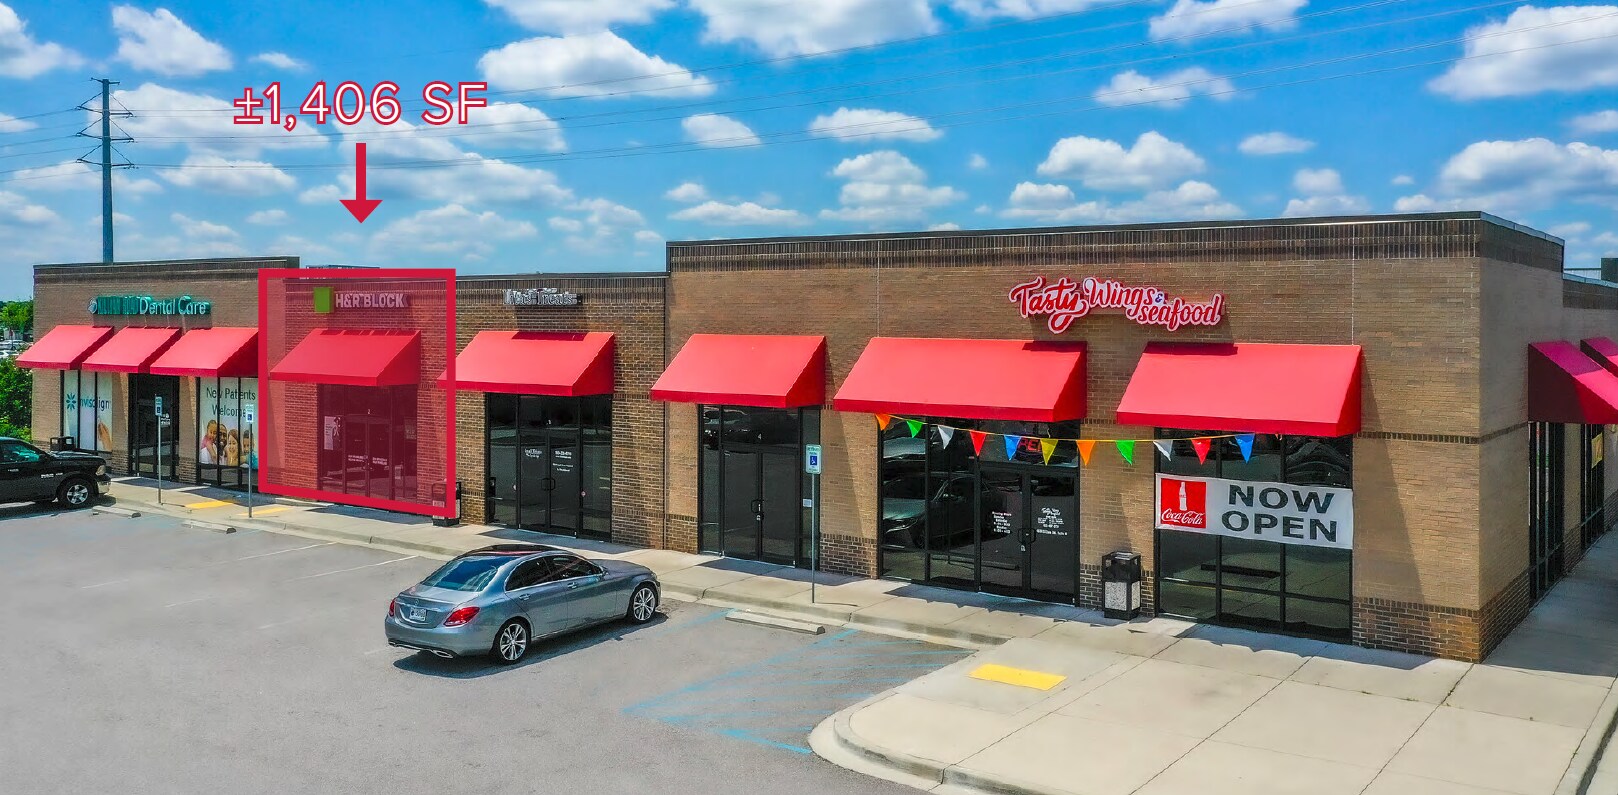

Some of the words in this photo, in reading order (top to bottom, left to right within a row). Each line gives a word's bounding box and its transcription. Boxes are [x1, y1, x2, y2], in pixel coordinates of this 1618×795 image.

[139, 296, 175, 315] Dental
[178, 296, 207, 315] Care
[336, 293, 360, 308] H&R
[363, 293, 405, 308] BLOCK
[1009, 277, 1089, 333] Tasty
[1083, 277, 1155, 320] Wings
[1138, 296, 1222, 331] seafood
[224, 387, 256, 401] Patents
[1228, 484, 1335, 514] NOW
[1161, 508, 1205, 525] Coca-Cola
[1221, 510, 1338, 543] OPEN
